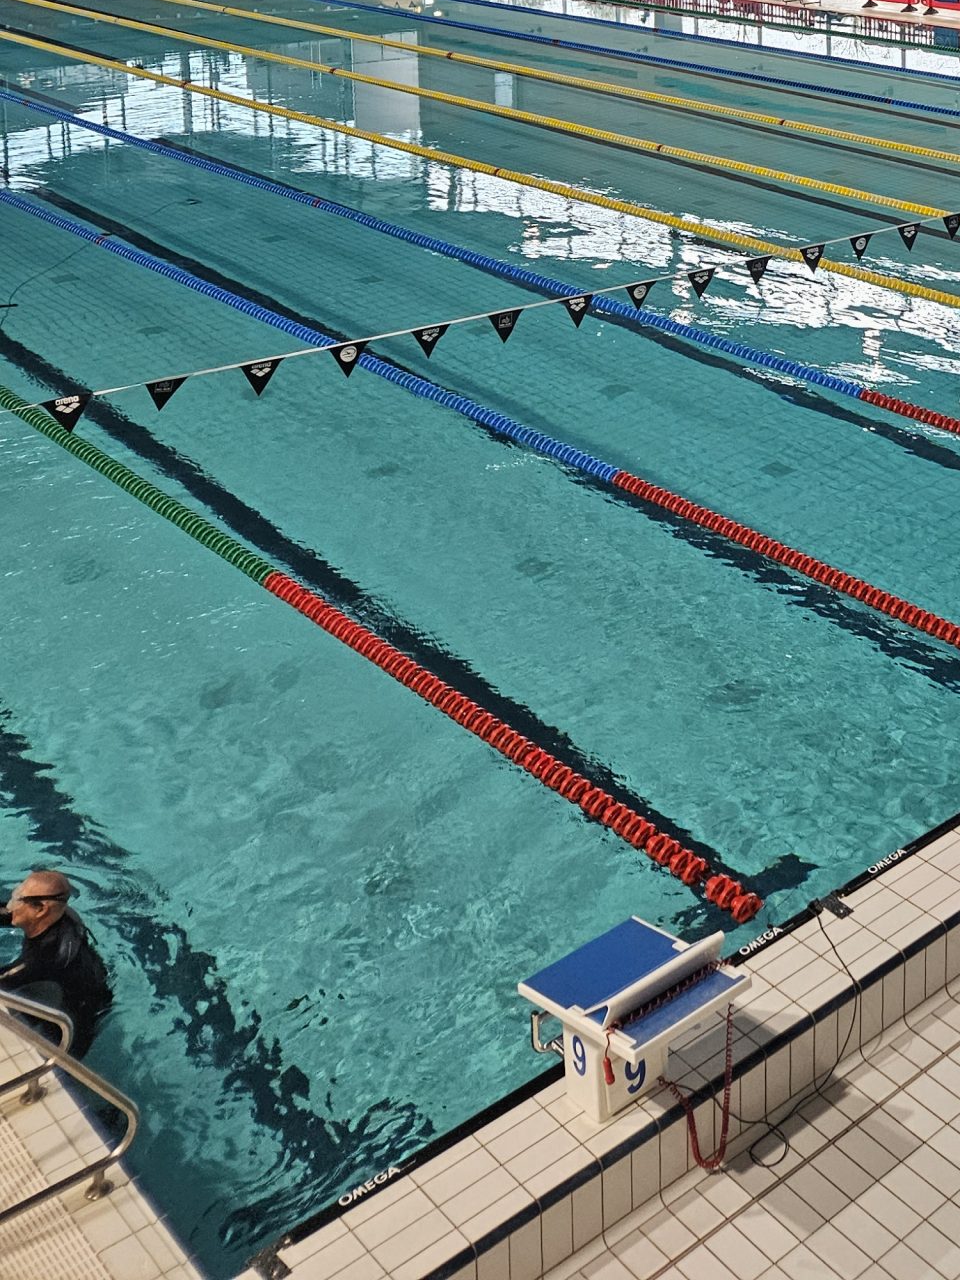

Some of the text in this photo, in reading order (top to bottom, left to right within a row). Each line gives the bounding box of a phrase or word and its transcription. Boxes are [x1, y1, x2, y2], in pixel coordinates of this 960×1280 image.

[422, 328, 440, 336] arena
[251, 362, 272, 370] arena
[55, 395, 79, 406] arena
[867, 848, 908, 874] OMEGA
[739, 926, 784, 955] OMEGA
[573, 1035, 586, 1076] 9
[338, 1166, 401, 1206] OMEGA
